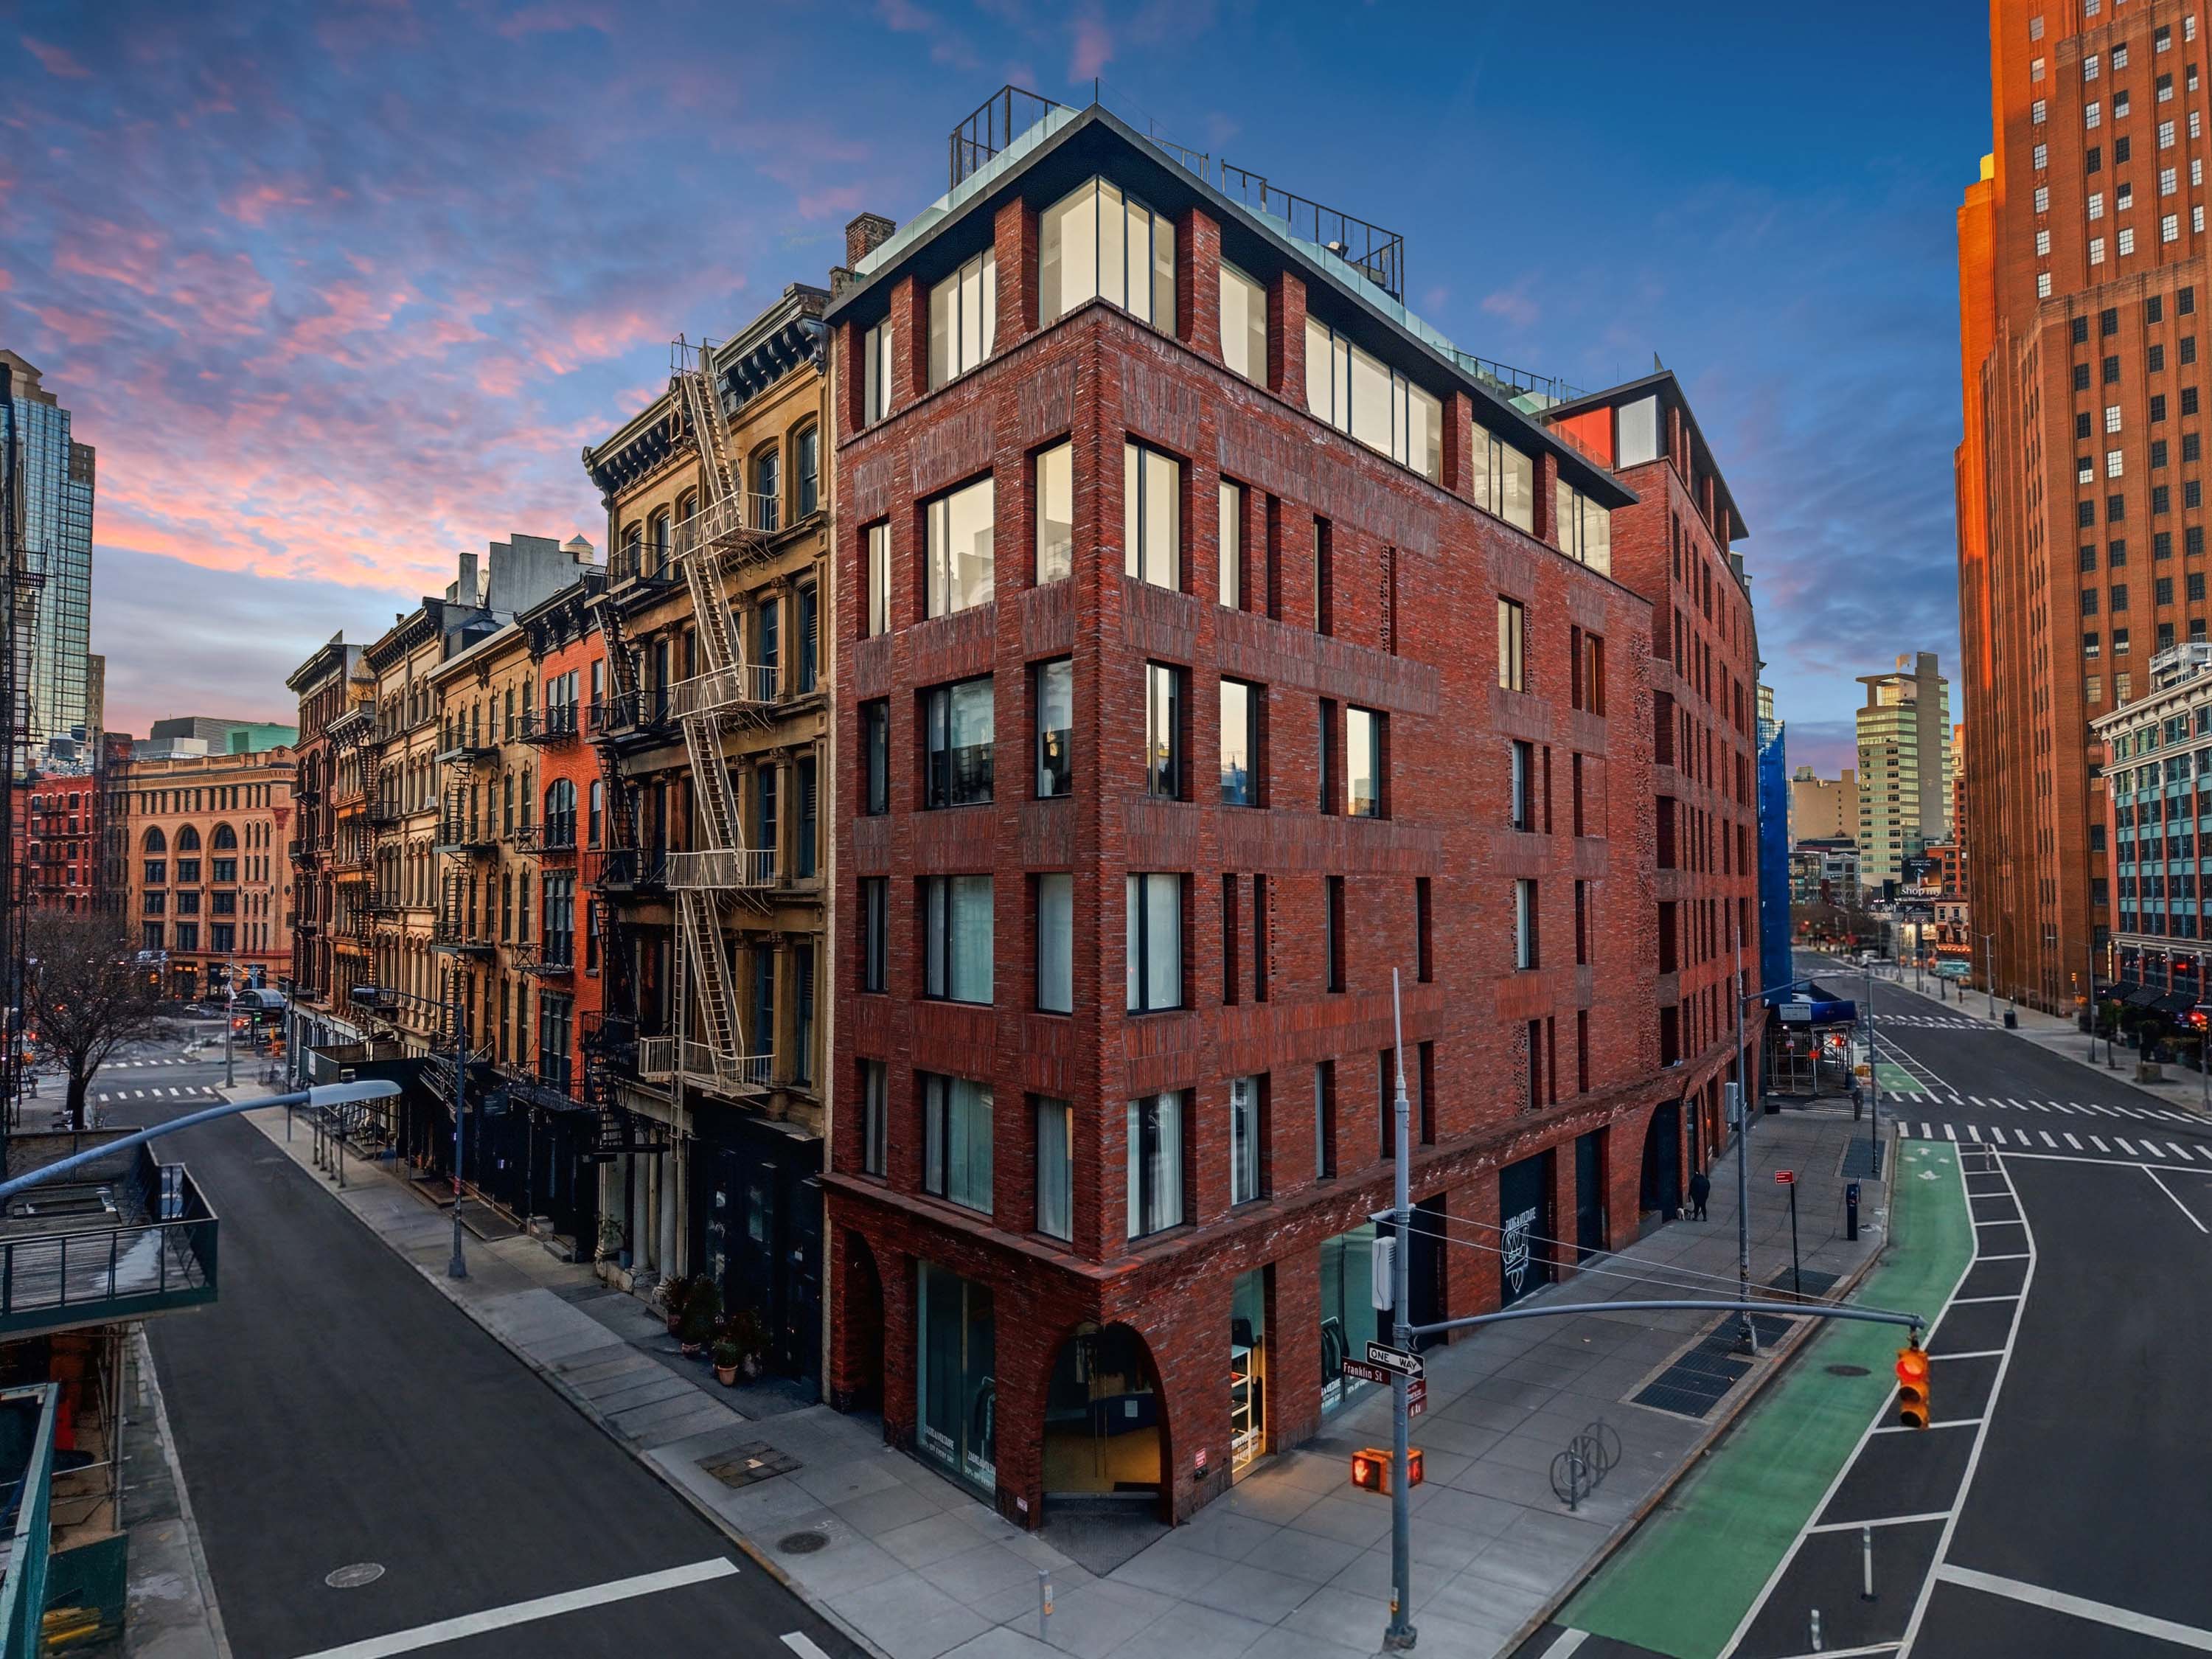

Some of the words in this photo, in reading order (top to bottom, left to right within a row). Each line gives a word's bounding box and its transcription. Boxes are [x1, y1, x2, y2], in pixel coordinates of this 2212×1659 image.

[1901, 886, 1924, 896] shop
[1926, 888, 1941, 897] my
[1371, 1349, 1390, 1363] ONE
[1399, 1358, 1417, 1370] WAY
[1343, 1362, 1372, 1379] Franklin
[1374, 1370, 1382, 1382] St
